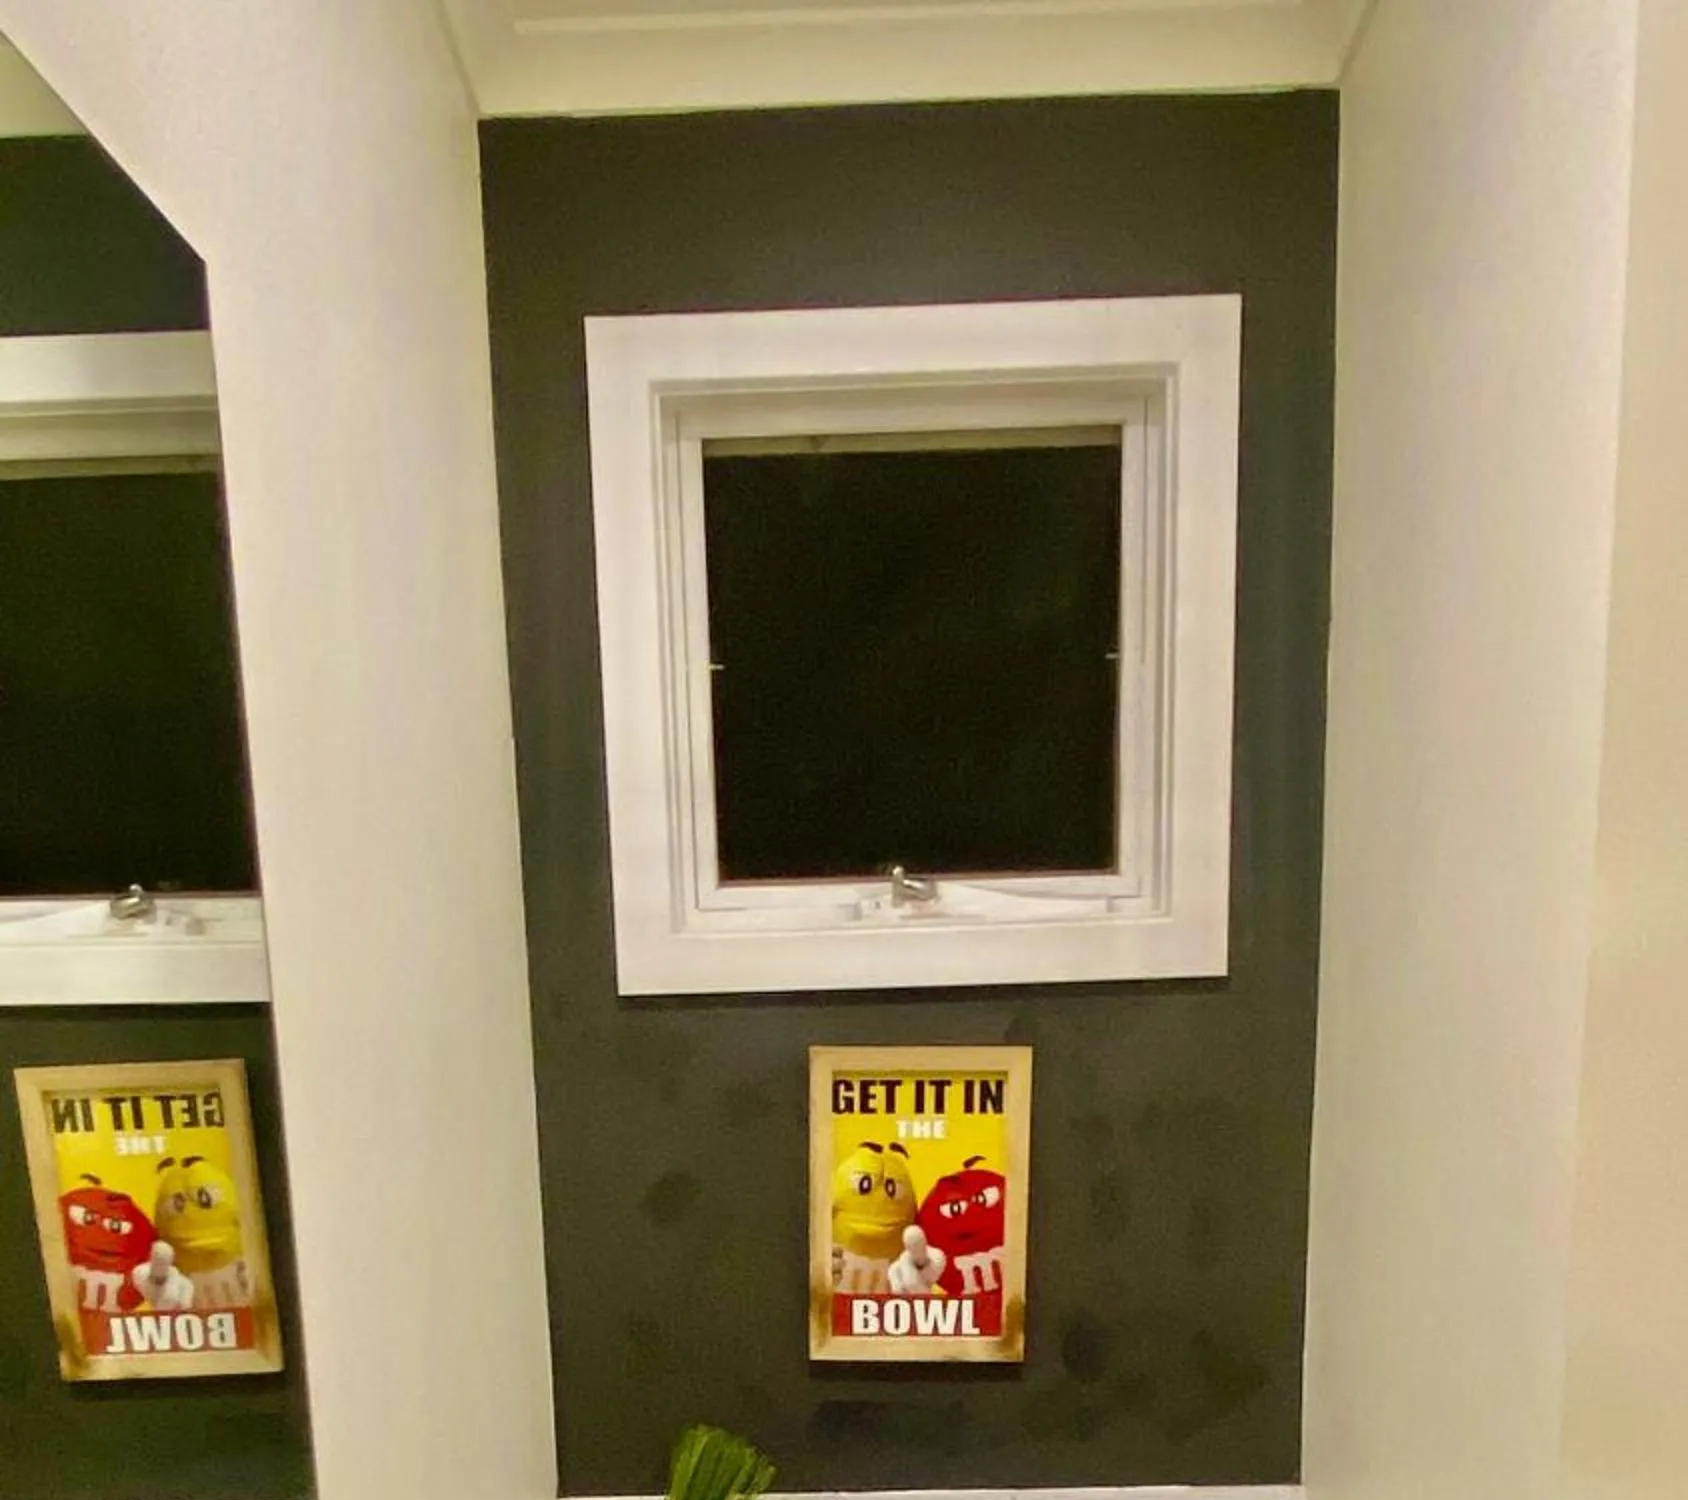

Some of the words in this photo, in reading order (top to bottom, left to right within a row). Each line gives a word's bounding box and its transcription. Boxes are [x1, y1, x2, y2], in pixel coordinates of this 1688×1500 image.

[831, 1078, 903, 1114] GET
[914, 1078, 951, 1114] IT
[963, 1078, 1004, 1114] IN
[896, 1119, 947, 1140] THE
[851, 1299, 981, 1336] BOWL
